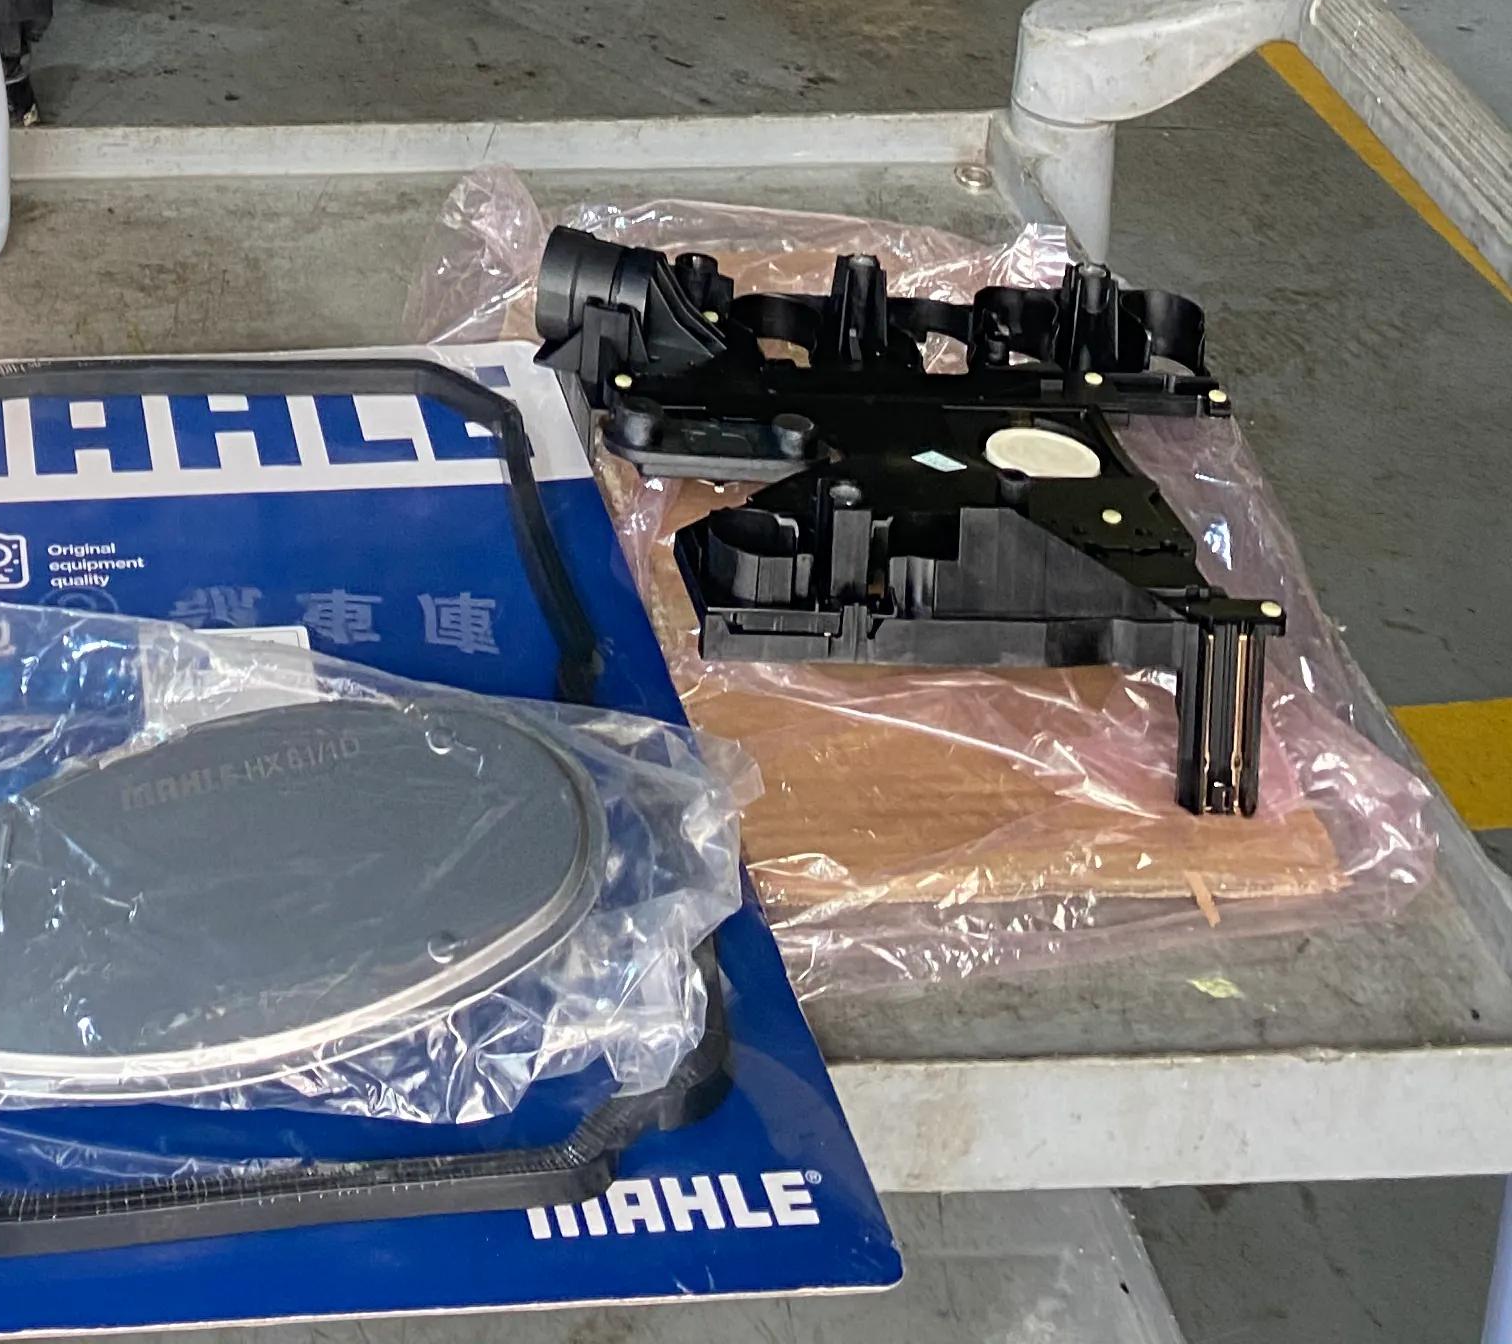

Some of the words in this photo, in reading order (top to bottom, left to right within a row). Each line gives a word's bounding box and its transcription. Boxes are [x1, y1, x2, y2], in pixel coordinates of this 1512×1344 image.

[47, 542, 116, 561] Original
[48, 556, 145, 574] equipment
[49, 572, 110, 589] quality
